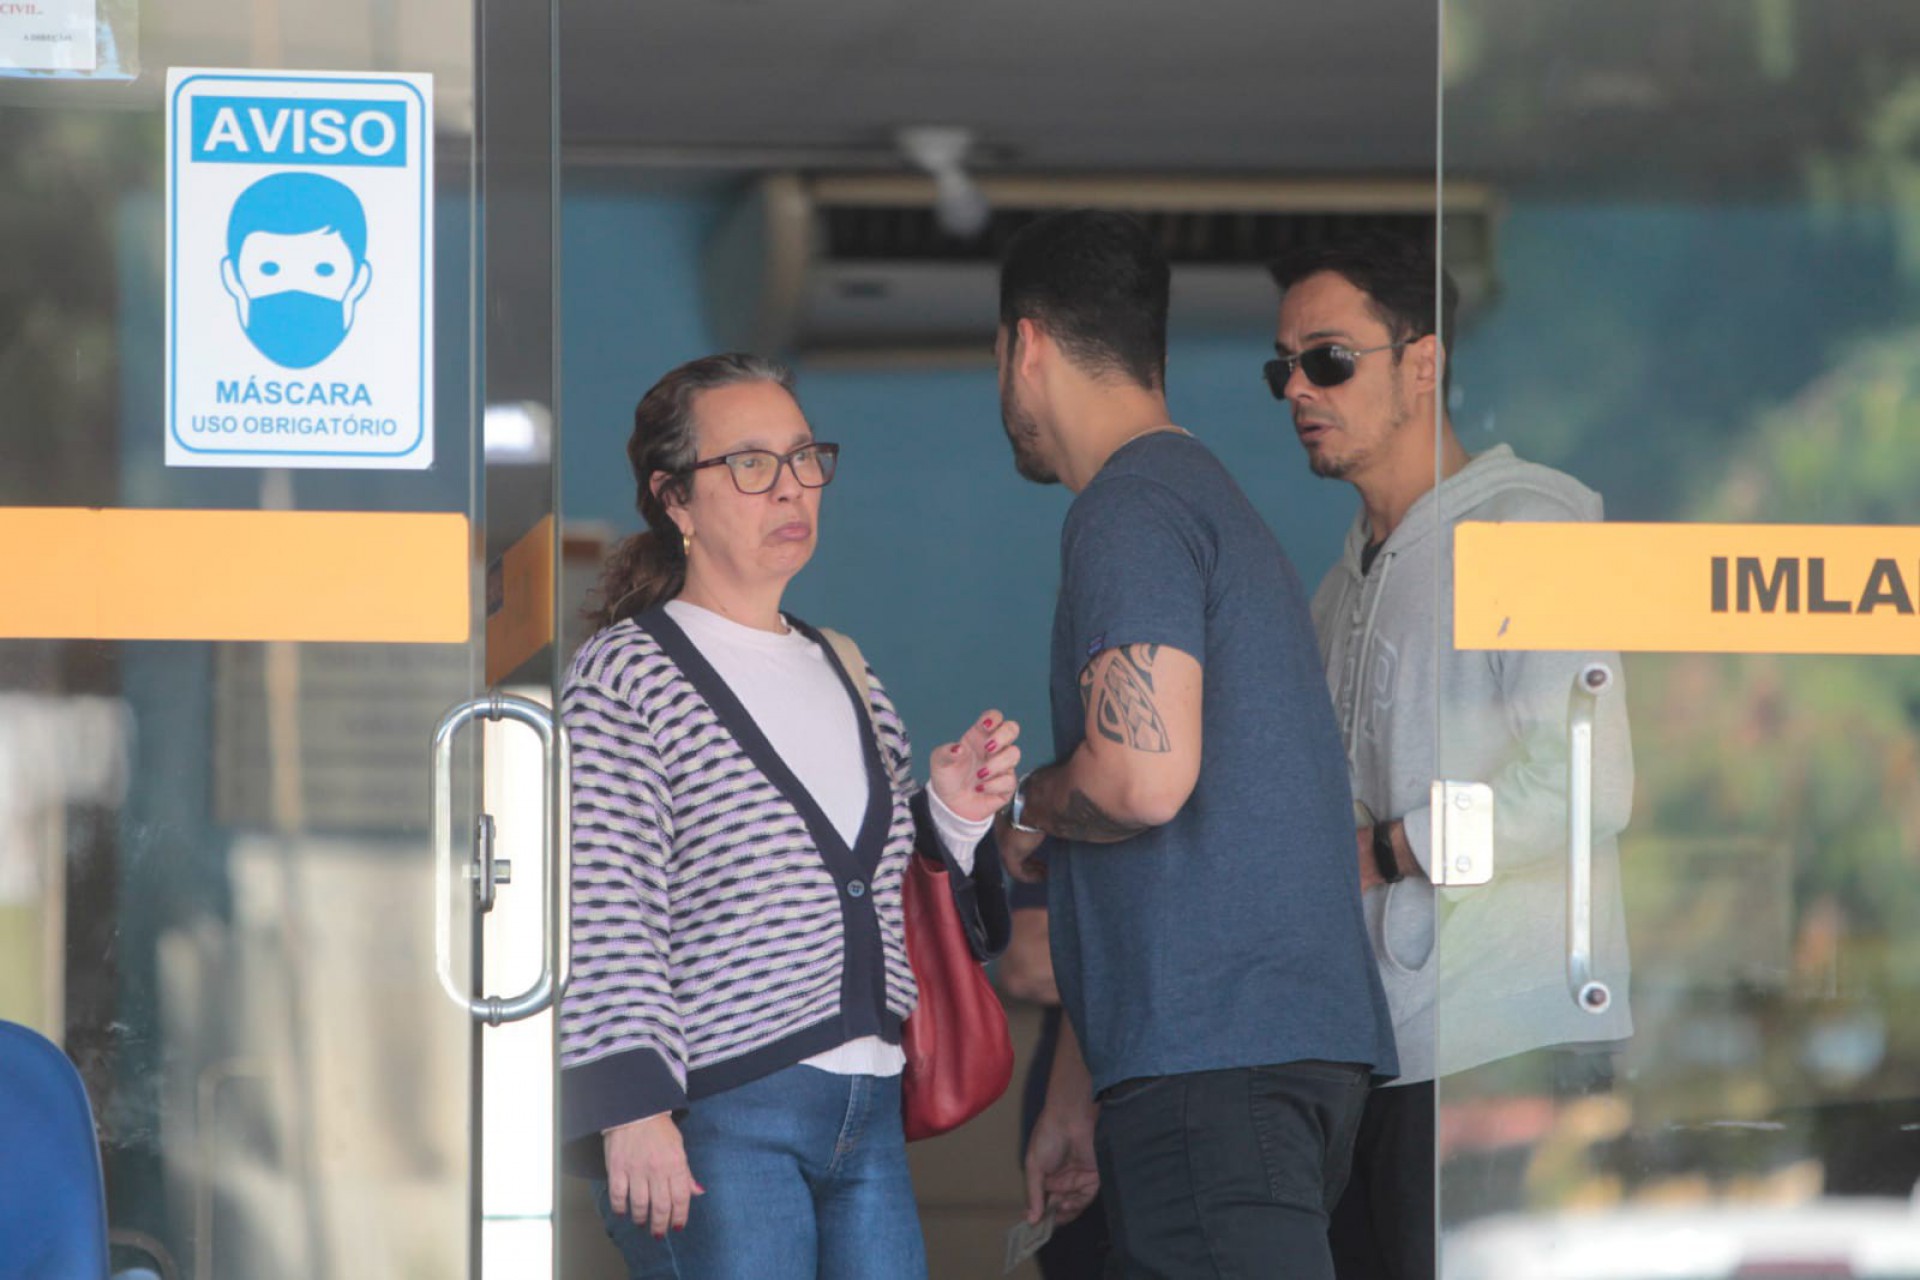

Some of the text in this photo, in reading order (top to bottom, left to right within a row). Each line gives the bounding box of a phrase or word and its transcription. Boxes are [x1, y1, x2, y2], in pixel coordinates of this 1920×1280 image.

[203, 107, 396, 156] AVISO
[216, 375, 372, 406] MÁSCARA
[191, 414, 397, 436] USO OBRIGATÓRIO
[1711, 556, 1920, 615] IMLA
